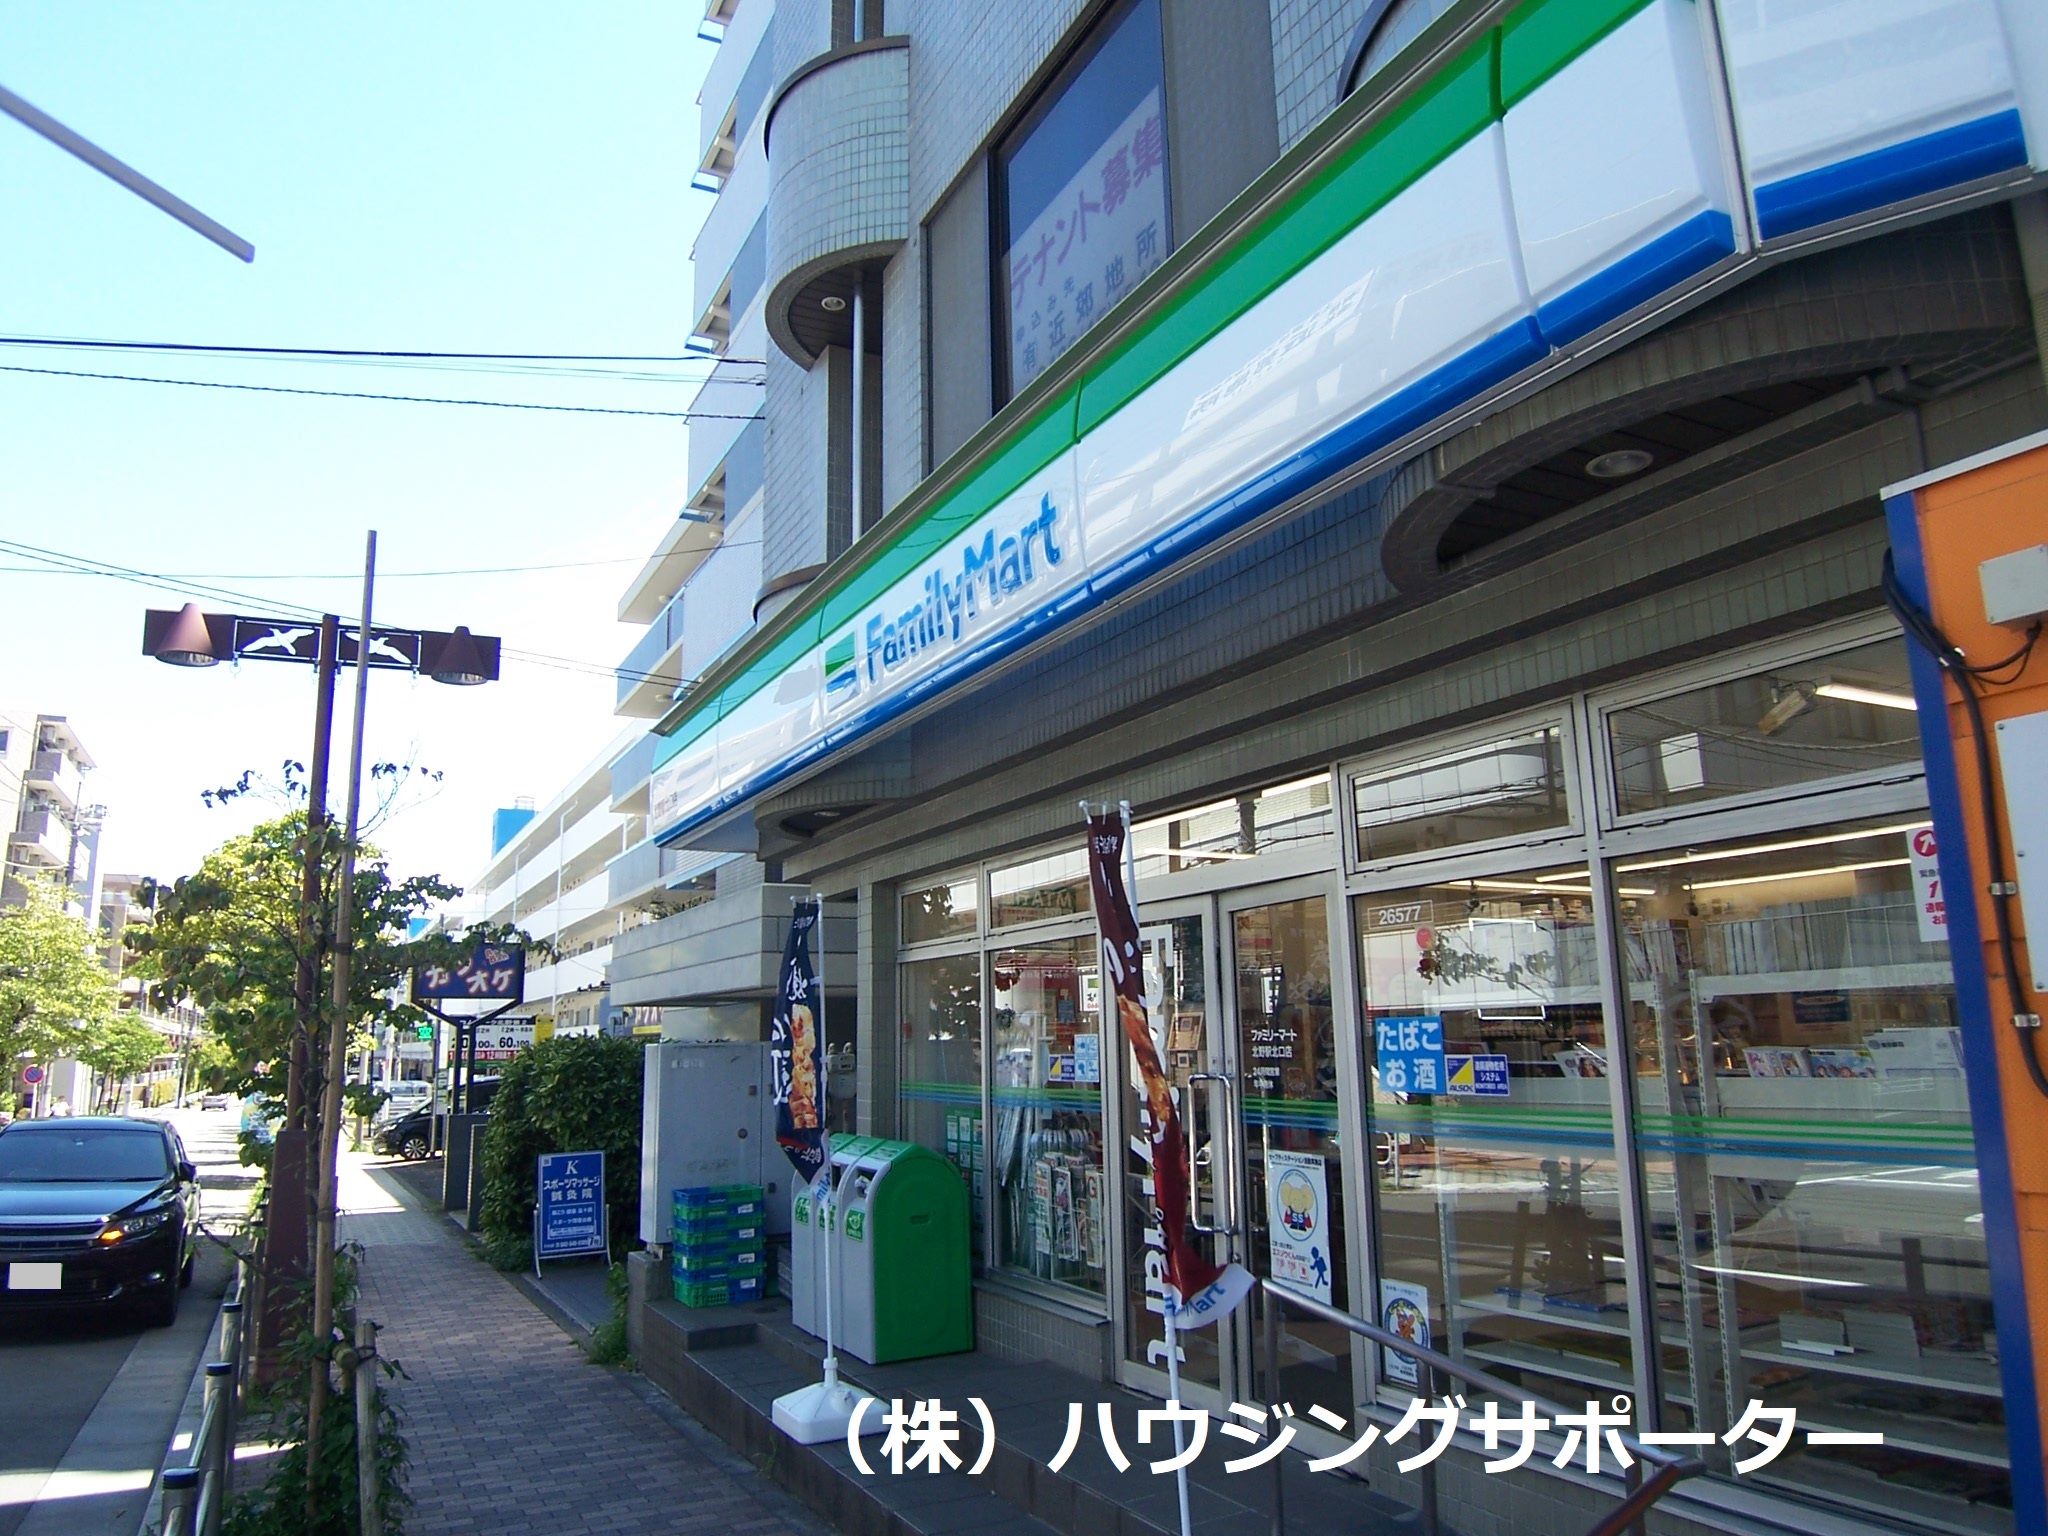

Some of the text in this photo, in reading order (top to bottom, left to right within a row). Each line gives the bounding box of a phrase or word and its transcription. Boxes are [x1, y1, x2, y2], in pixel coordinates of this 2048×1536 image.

[1011, 113, 1163, 312] テナント募集
[866, 490, 1062, 685] FamilyMart
[1378, 904, 1422, 925] 26577
[1250, 1028, 1298, 1042] ファミリーマート
[1377, 1020, 1442, 1052] たばこ
[1385, 1057, 1437, 1091] お酒
[1449, 1084, 1474, 1092] ALSOK
[565, 1159, 579, 1175] K
[543, 1175, 601, 1191] スポーツマッサージ
[1292, 1213, 1304, 1224] SS
